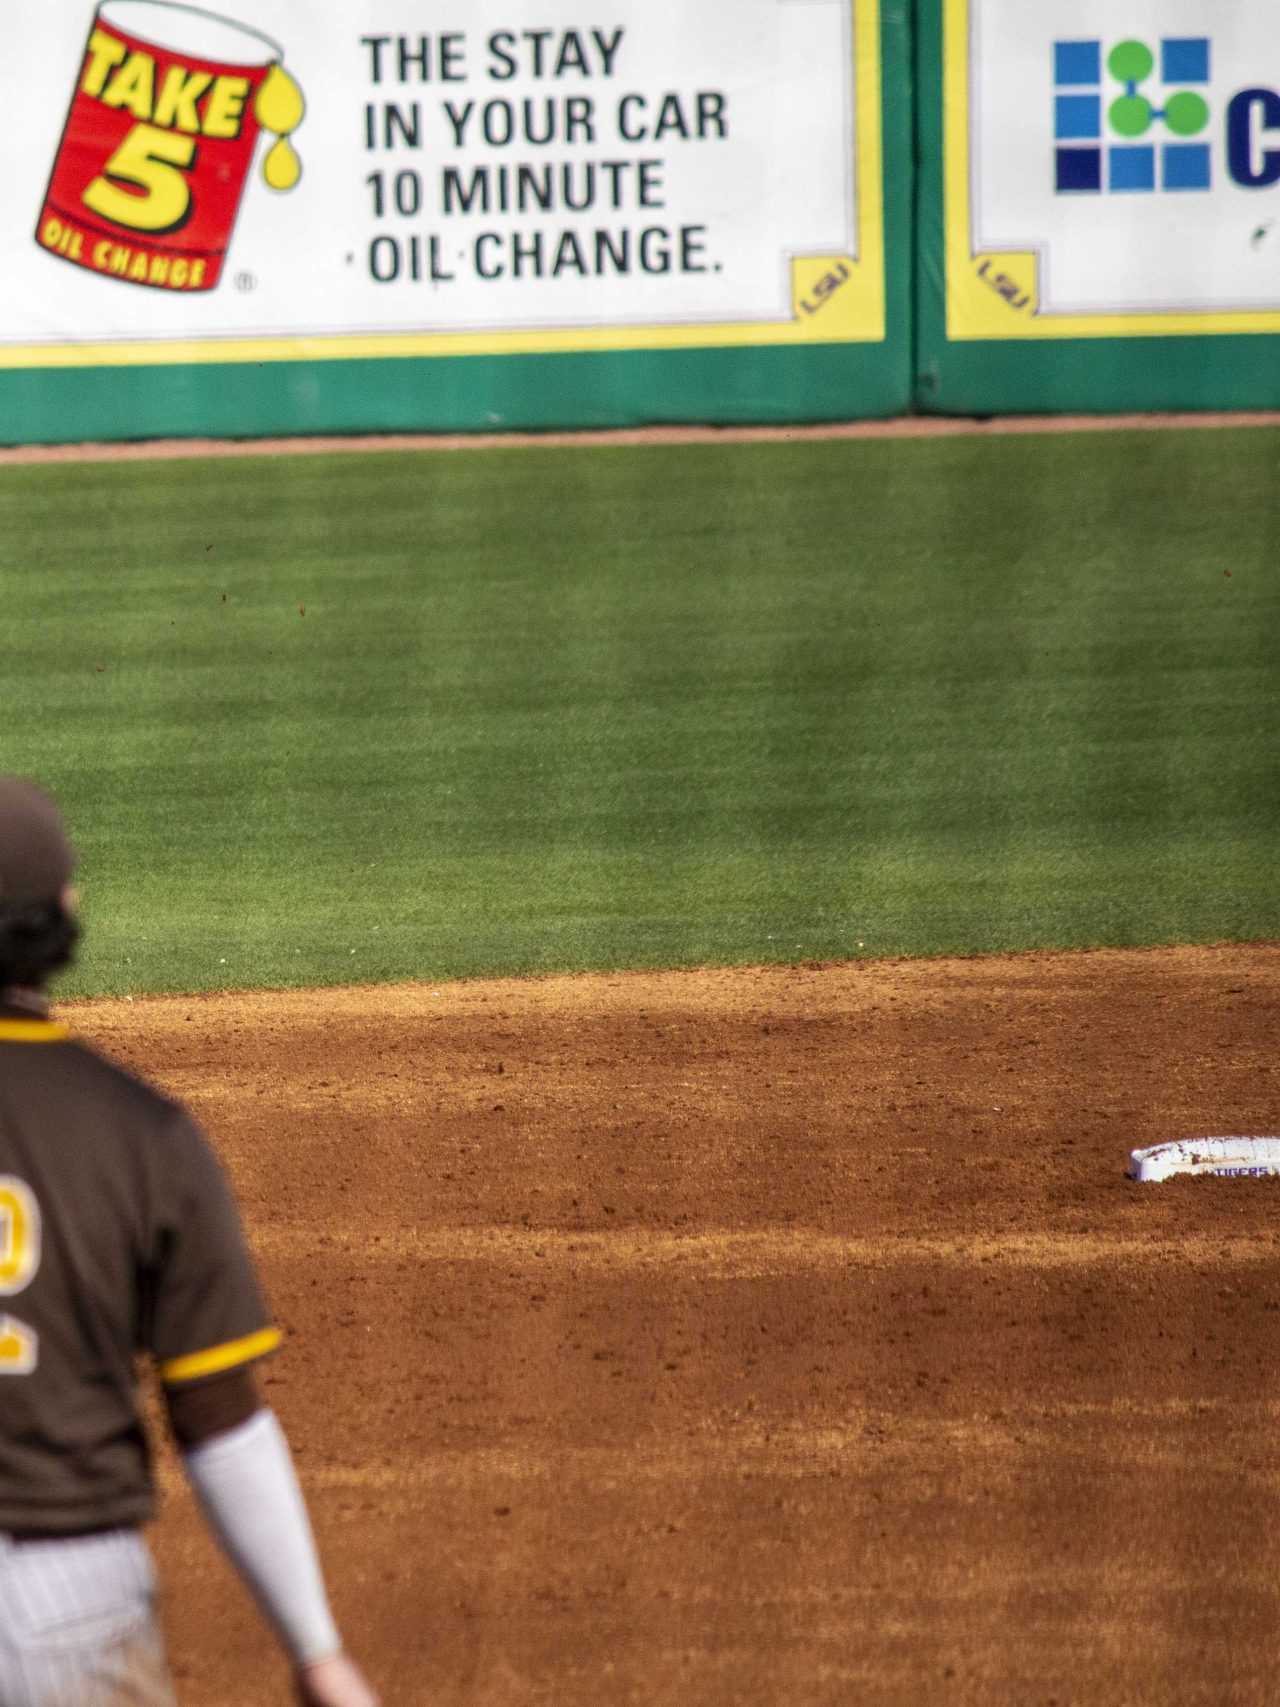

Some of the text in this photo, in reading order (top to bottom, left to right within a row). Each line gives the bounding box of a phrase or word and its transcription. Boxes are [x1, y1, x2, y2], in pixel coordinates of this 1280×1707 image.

[81, 28, 252, 140] TAKE
[361, 28, 624, 84] THE STAY
[365, 92, 727, 149] IN YOUR CAR
[82, 120, 199, 237] 5
[367, 160, 665, 216] 10 MINUTE
[41, 217, 84, 261] OIL
[91, 239, 208, 289] CHANGE
[369, 226, 723, 283] OIL CHANGE.
